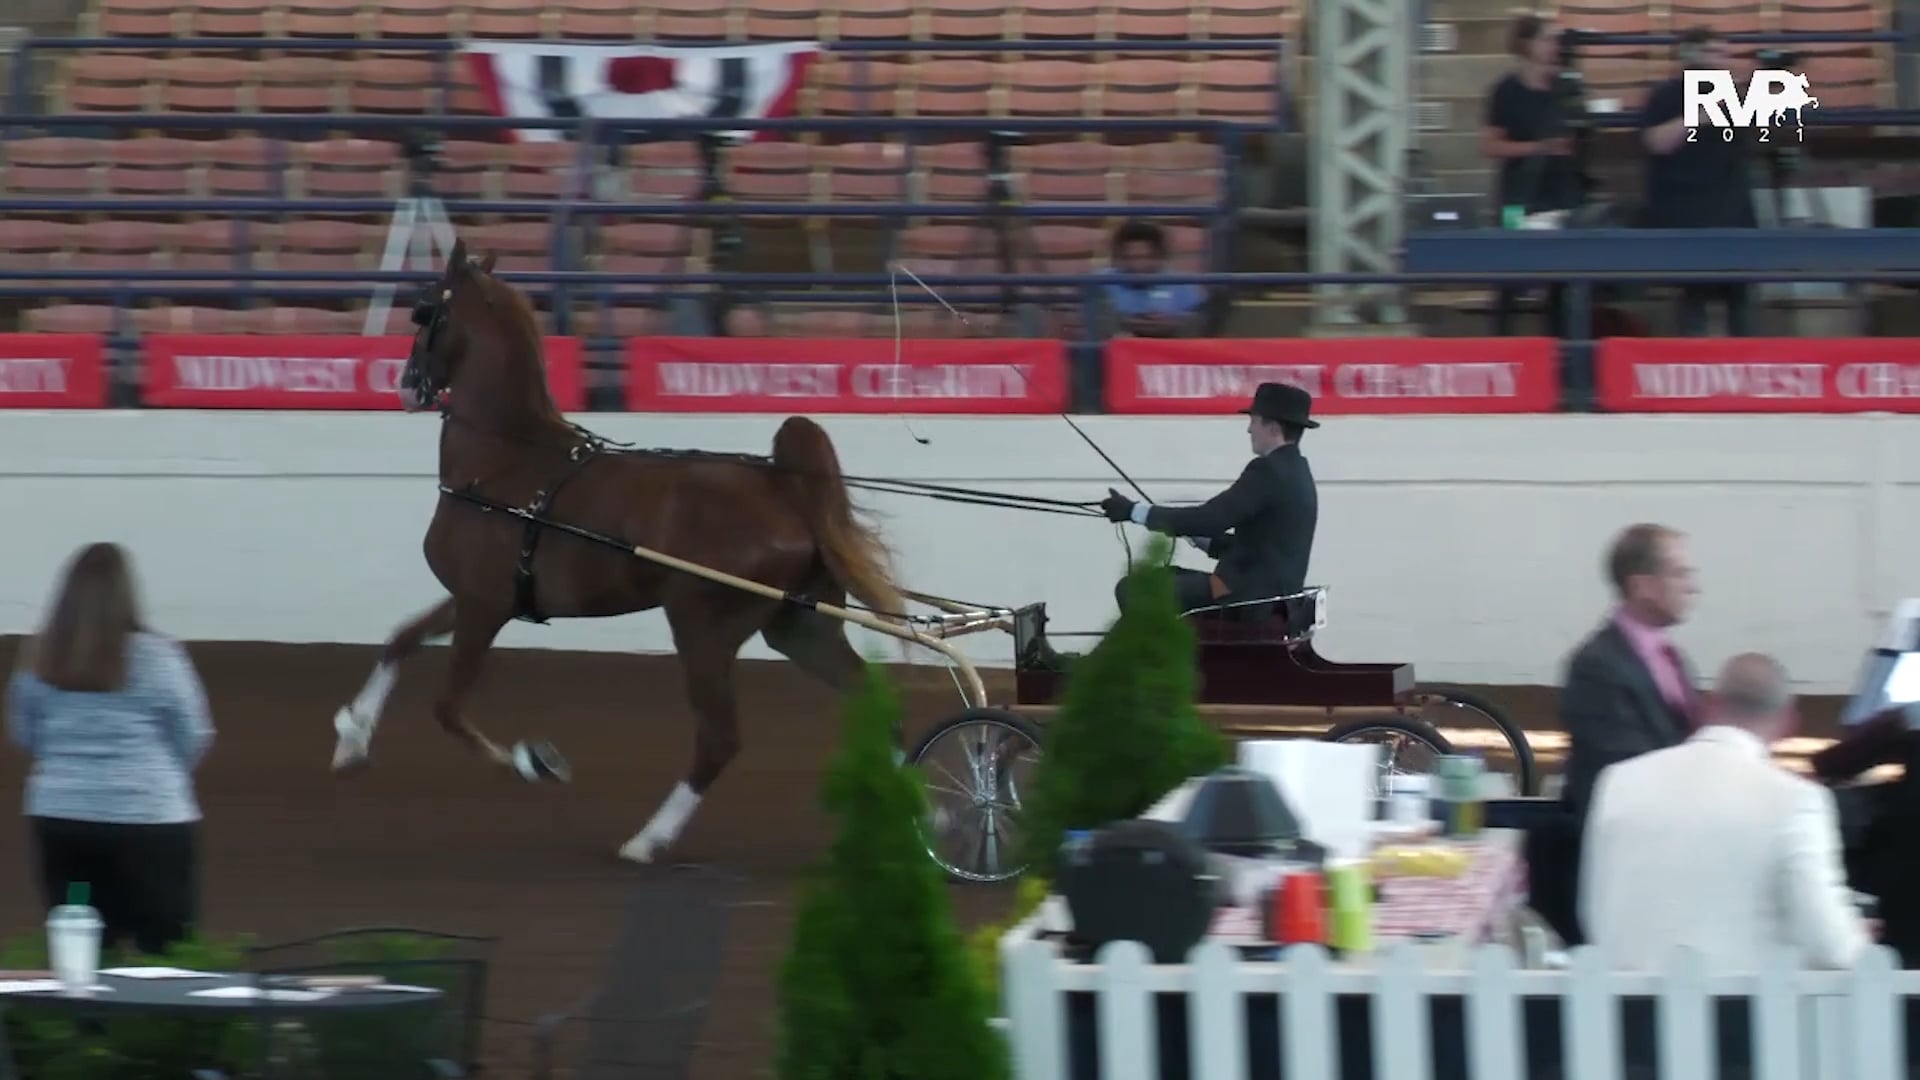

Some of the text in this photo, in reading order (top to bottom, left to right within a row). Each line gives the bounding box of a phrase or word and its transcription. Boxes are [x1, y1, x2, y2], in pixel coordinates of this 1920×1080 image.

[173, 356, 360, 392] MIDWEST
[656, 362, 1034, 398] MIDWEST CHARITY
[1334, 363, 1523, 398] CHARITY
[1632, 363, 1828, 398] MIDWEST
